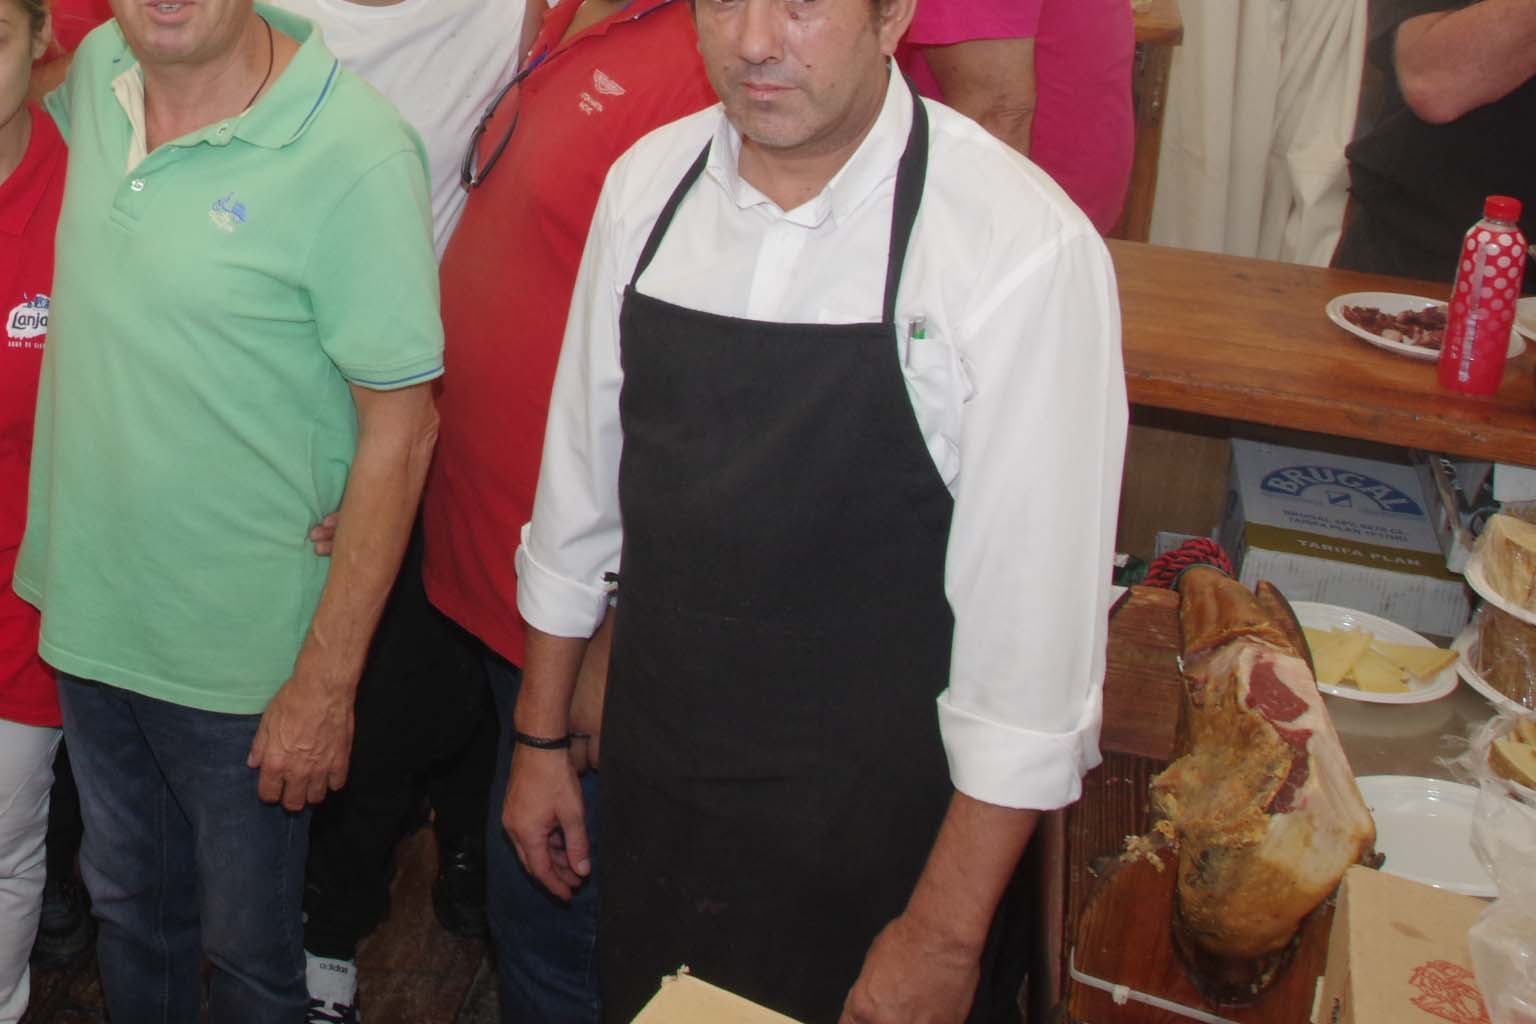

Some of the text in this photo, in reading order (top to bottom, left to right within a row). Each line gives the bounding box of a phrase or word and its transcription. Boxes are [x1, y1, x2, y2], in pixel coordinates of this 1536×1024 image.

[1265, 465, 1409, 512] BRUGAL
[1296, 539, 1424, 567] TARIFA PLAN
